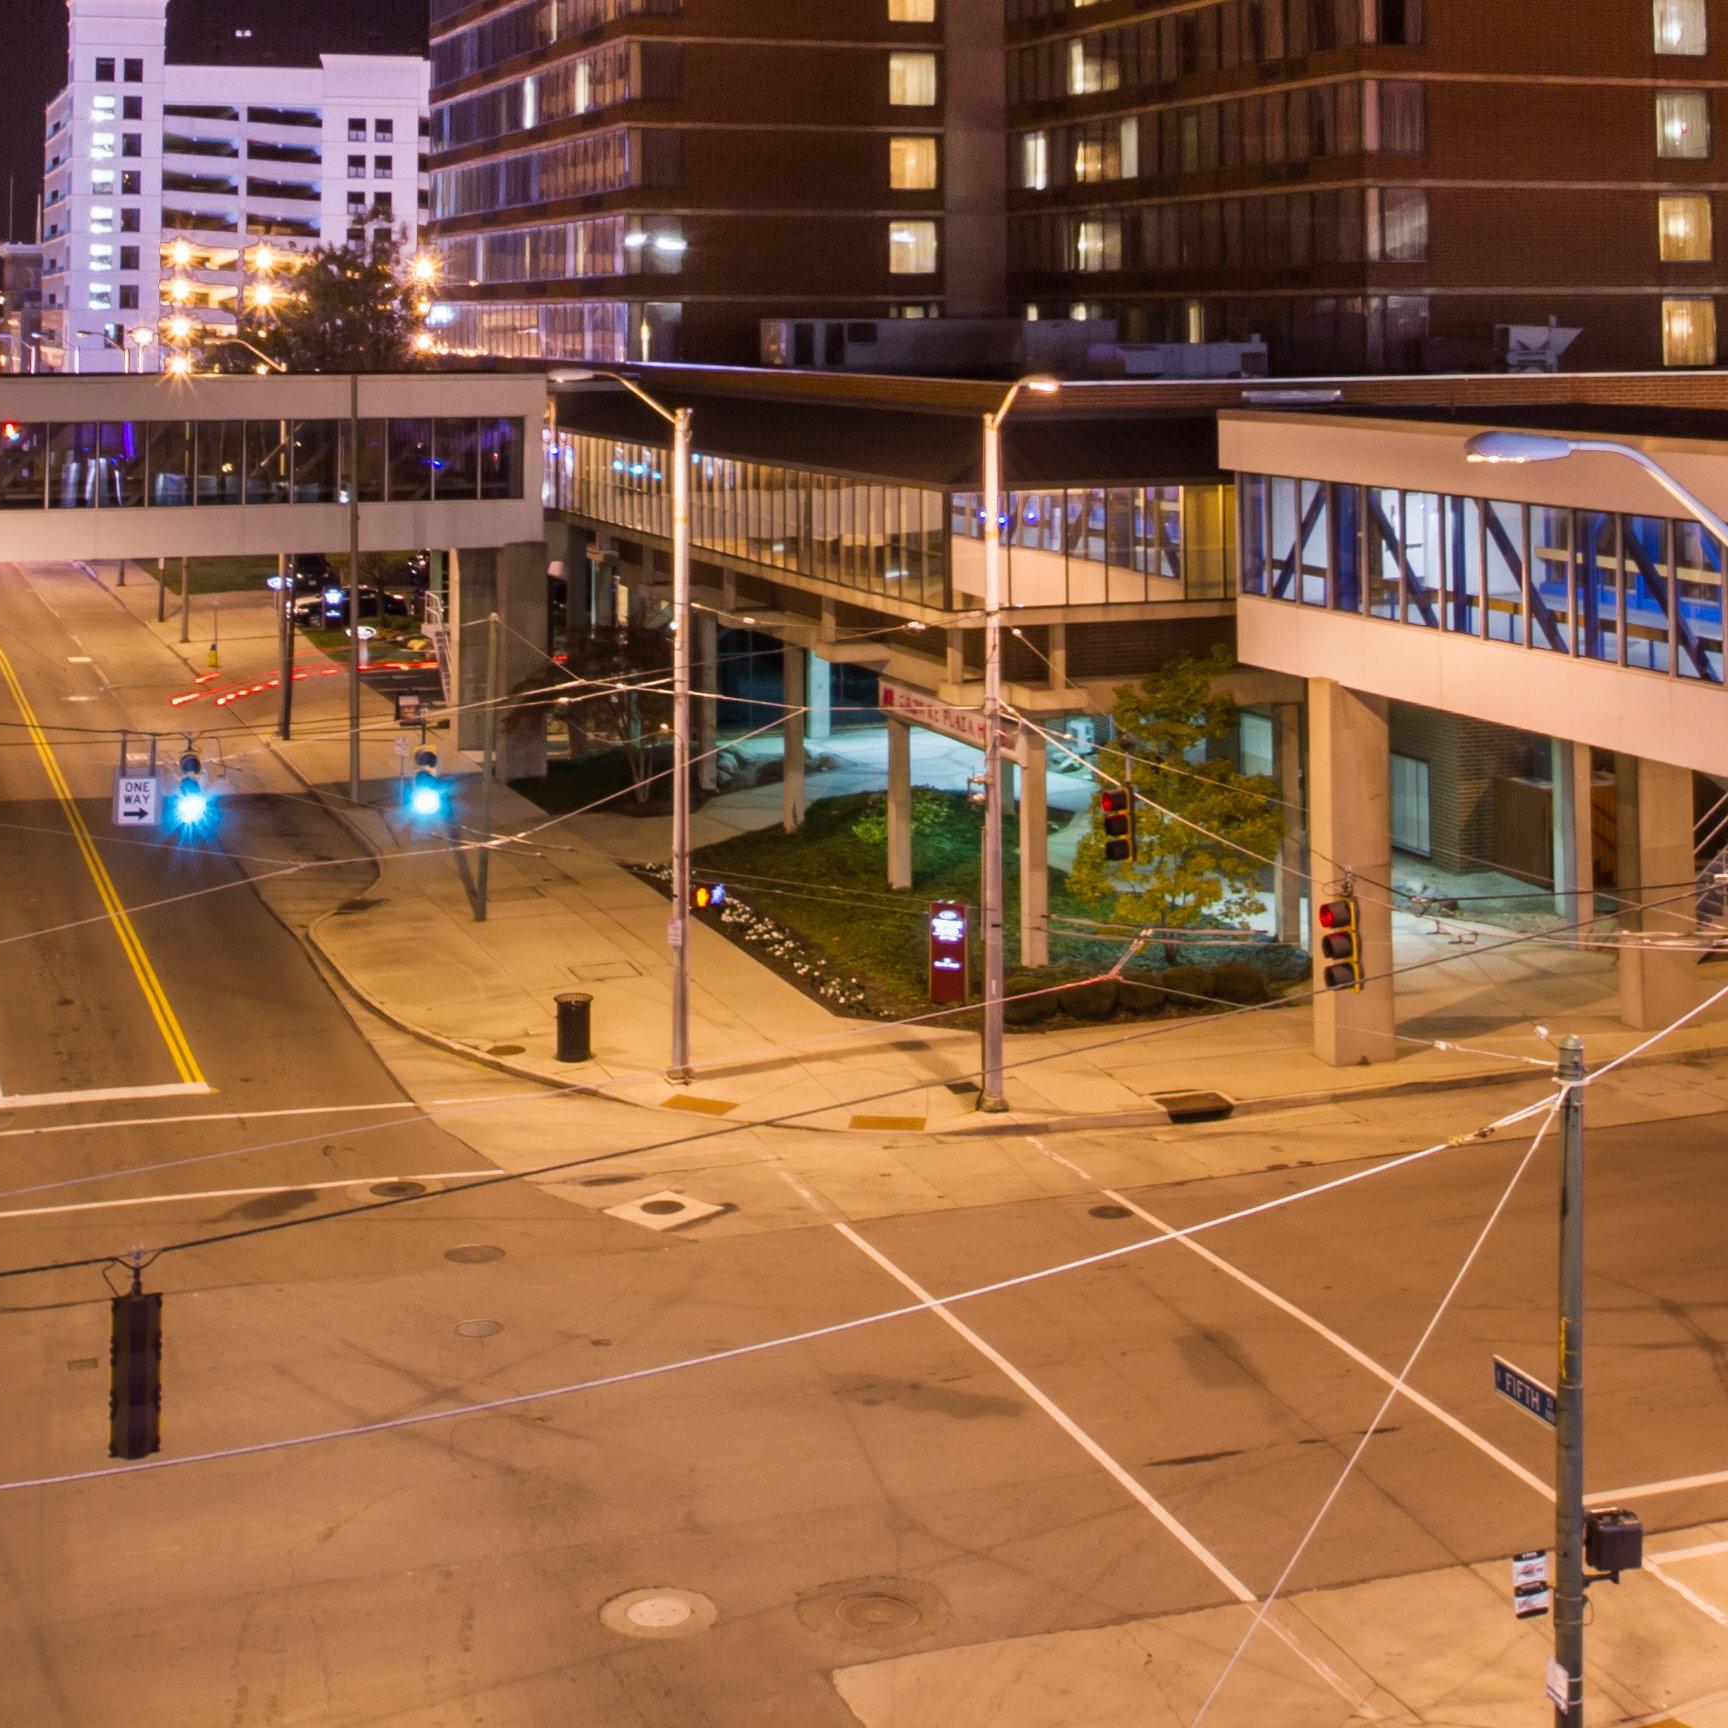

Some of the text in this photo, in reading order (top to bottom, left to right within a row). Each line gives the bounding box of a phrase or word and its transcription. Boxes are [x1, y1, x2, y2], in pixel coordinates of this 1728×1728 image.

[125, 782, 150, 792] ONE
[124, 794, 150, 805] WAY
[1505, 1372, 1540, 1412] FIFTH
